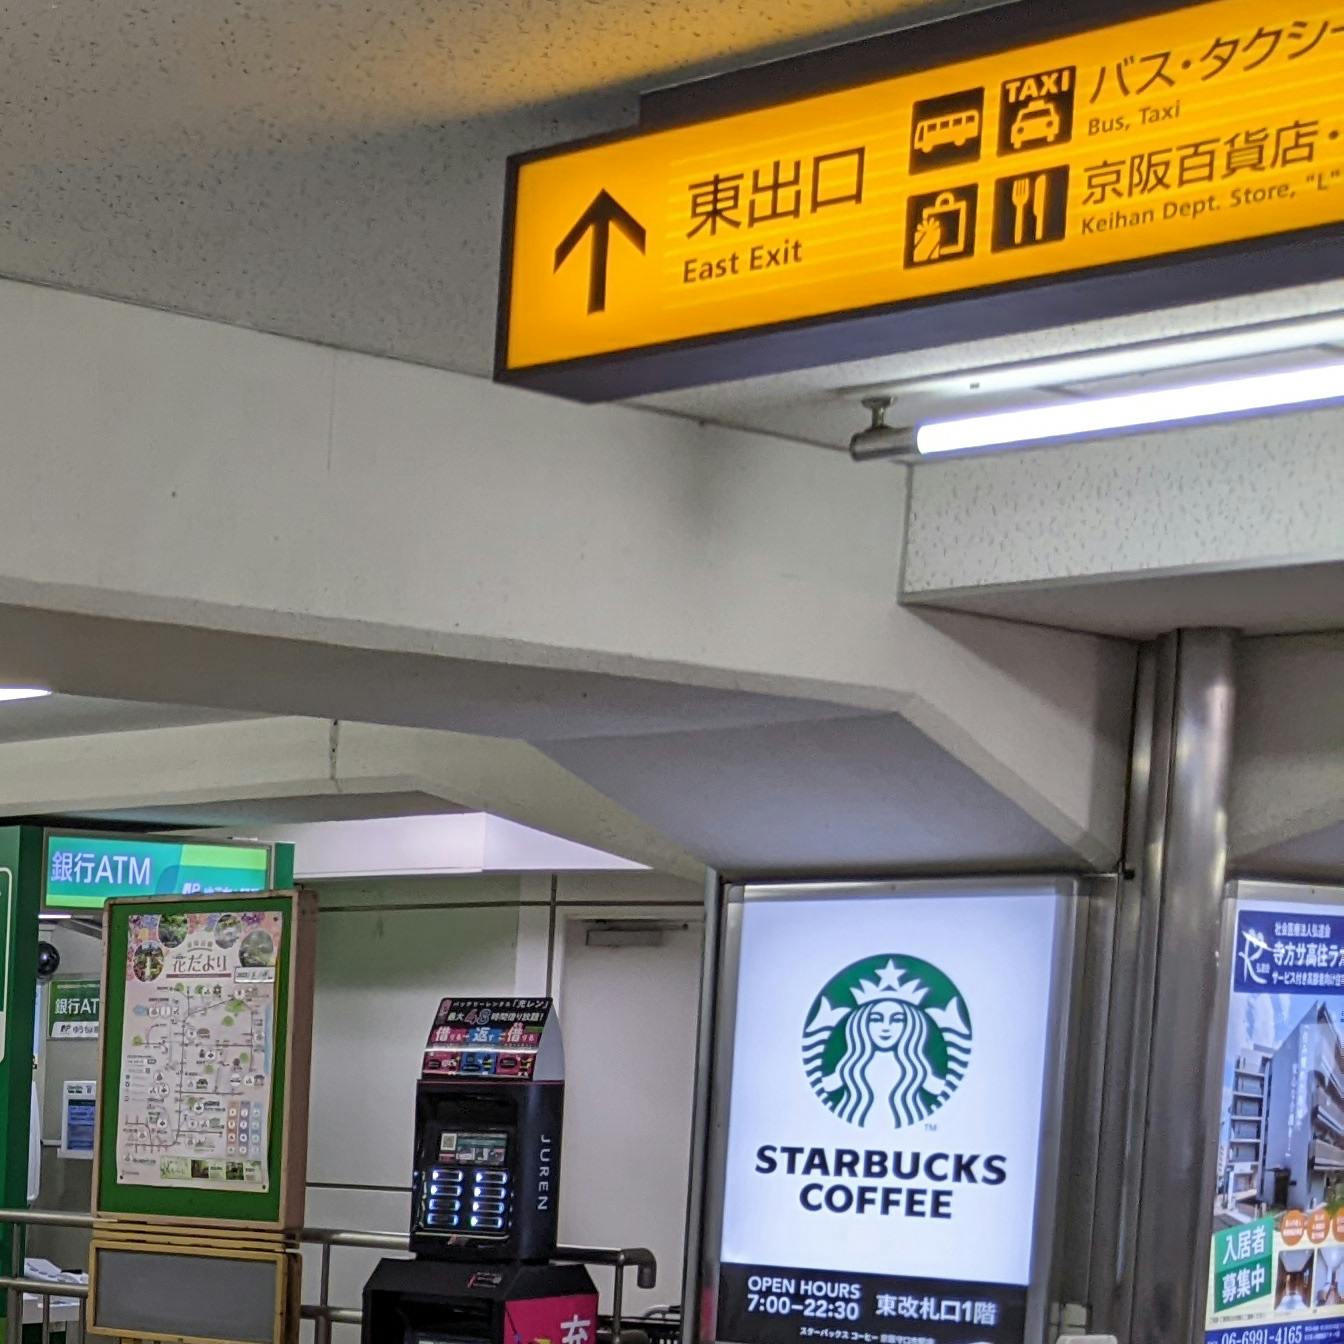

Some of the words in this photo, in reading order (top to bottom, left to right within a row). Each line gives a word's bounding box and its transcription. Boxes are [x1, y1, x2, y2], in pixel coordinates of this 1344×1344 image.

[1006, 69, 1070, 103] TAXI
[1088, 116, 1129, 135] Bus,
[1140, 100, 1180, 125] Taxi
[686, 145, 865, 240] 東出口
[1081, 208, 1154, 235] Keihan
[1163, 195, 1220, 219] Dept.
[1230, 182, 1296, 207] Store,
[683, 252, 739, 284] East
[750, 238, 802, 271] Exit
[51, 851, 151, 886] 銀行ATM
[537, 1134, 551, 1211] JUREN
[754, 1143, 1008, 1186] STARBUCKS
[798, 1182, 954, 1220] COFFEE
[1222, 1224, 1267, 1265] 入居者
[747, 1275, 796, 1296] OPEN
[799, 1279, 862, 1300] HOURS
[1221, 1263, 1265, 1304] 募集中
[875, 1293, 998, 1326] 東改札口1階
